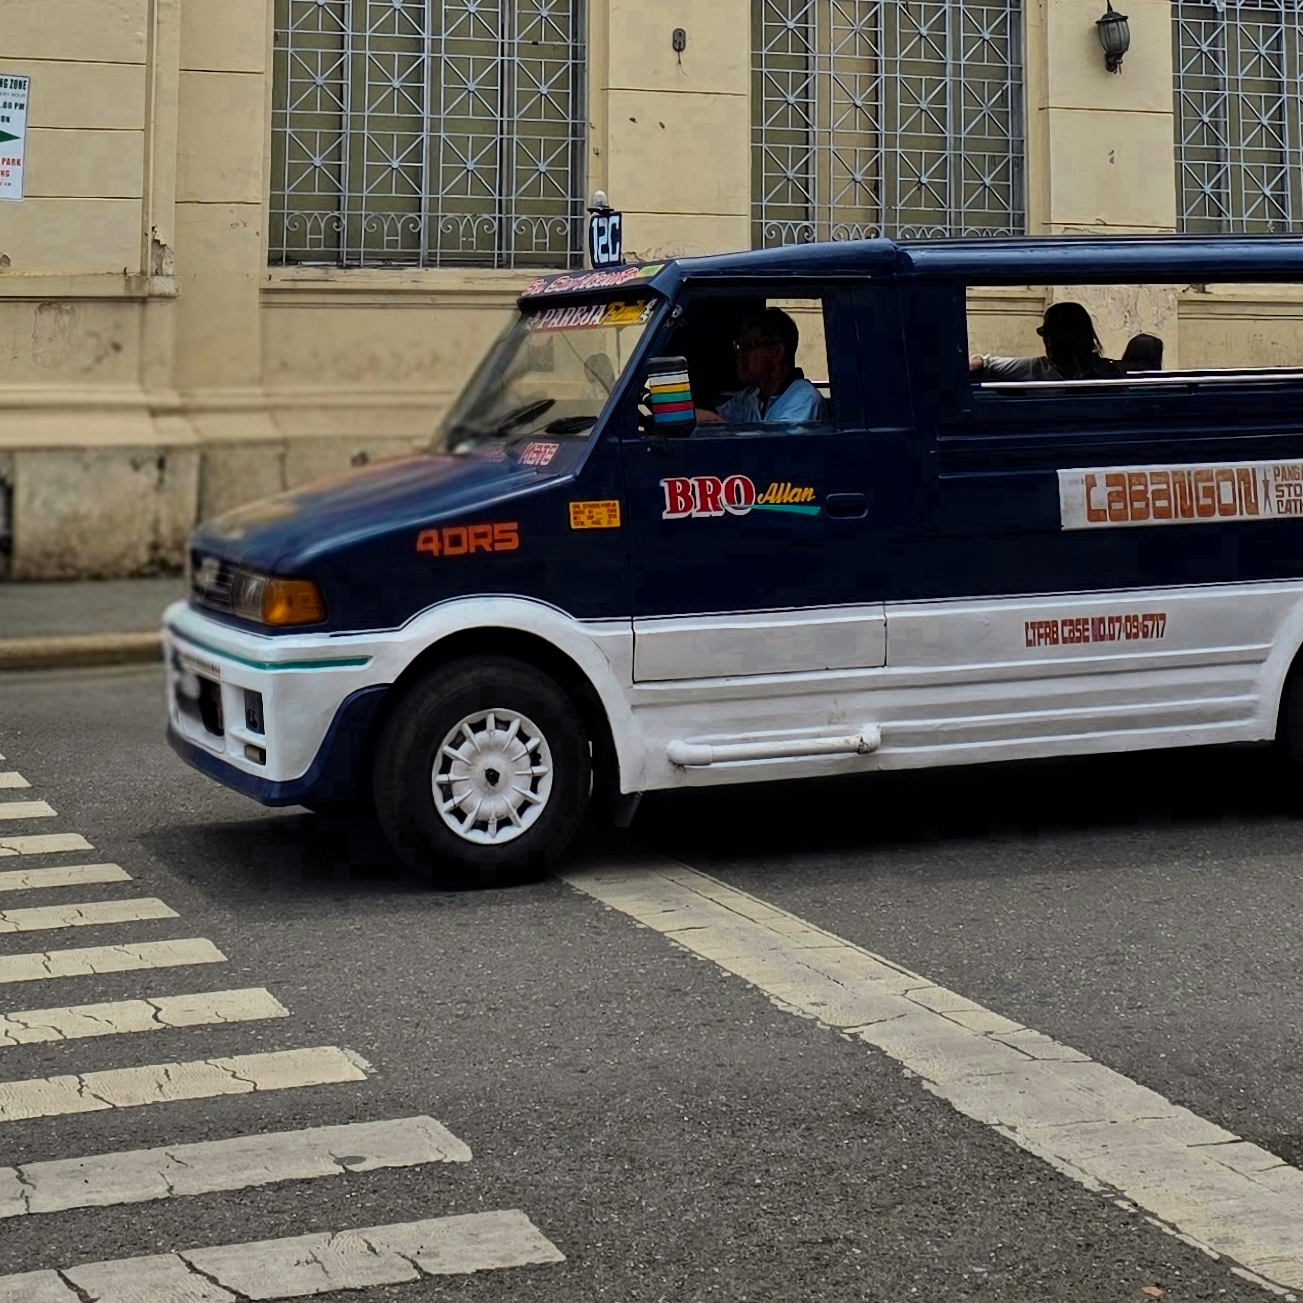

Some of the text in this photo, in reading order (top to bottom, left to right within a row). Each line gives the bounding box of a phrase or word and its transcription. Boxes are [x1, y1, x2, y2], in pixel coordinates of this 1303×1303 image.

[9, 78, 27, 91] ZONE
[14, 102, 25, 110] PM
[1, 157, 21, 166] PARK
[592, 215, 620, 264] 12C
[537, 304, 607, 329] PAREJA
[659, 474, 816, 519] BRO Allan
[416, 522, 519, 557] 4DR5
[1024, 620, 1059, 647] LTFRB
